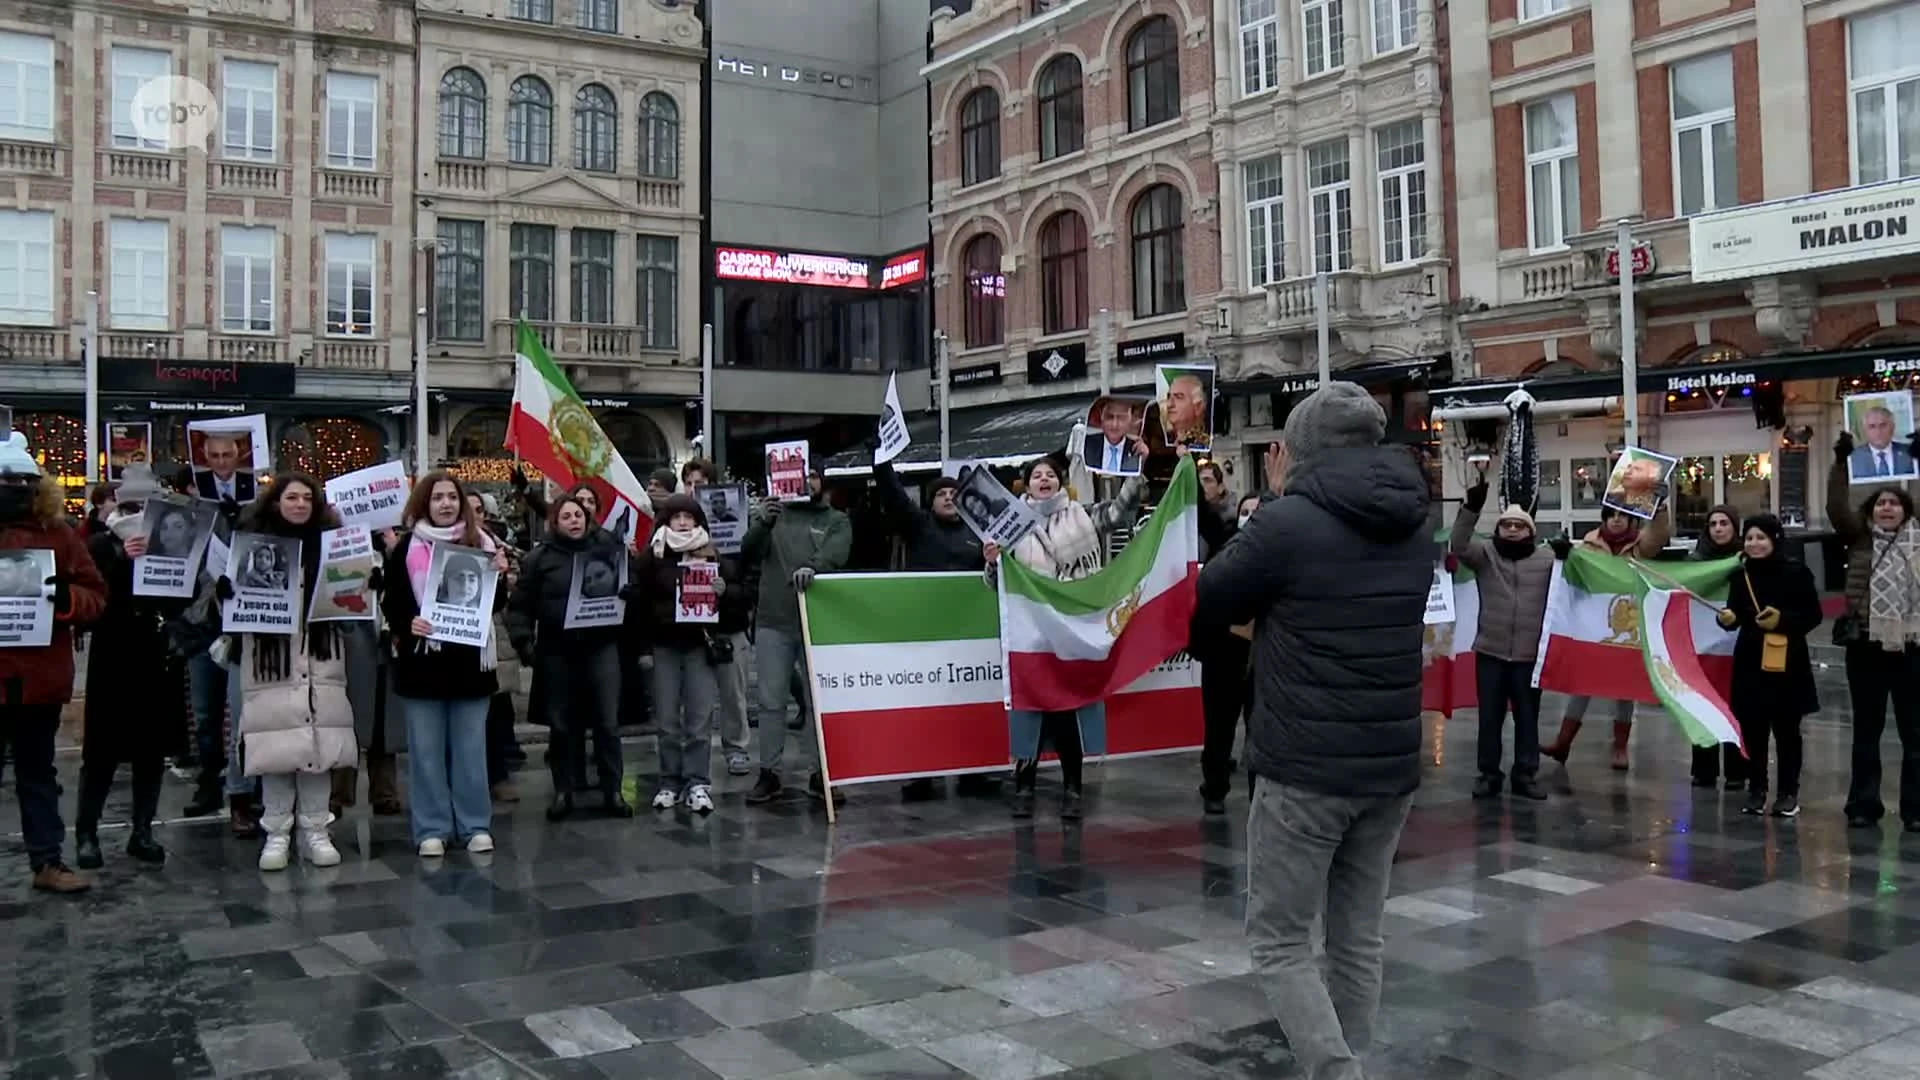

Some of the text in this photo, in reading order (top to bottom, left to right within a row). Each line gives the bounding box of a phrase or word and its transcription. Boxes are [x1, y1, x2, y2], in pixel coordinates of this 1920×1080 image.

[1792, 211, 1827, 224] Hotel
[1844, 198, 1915, 216] Brasserie
[1800, 216, 1907, 250] MALON
[719, 251, 868, 277] CASPAR AUWERKERKEN
[719, 265, 792, 280] RELEASE SHOW
[1873, 358, 1920, 373] Brass
[1282, 379, 1320, 393] A La Sir
[1668, 371, 1756, 390] Hotel Malon
[244, 601, 271, 610] years
[273, 602, 288, 611] old
[442, 614, 465, 625] years
[466, 617, 480, 627] old
[816, 661, 1003, 688] This is the voice of Irania
